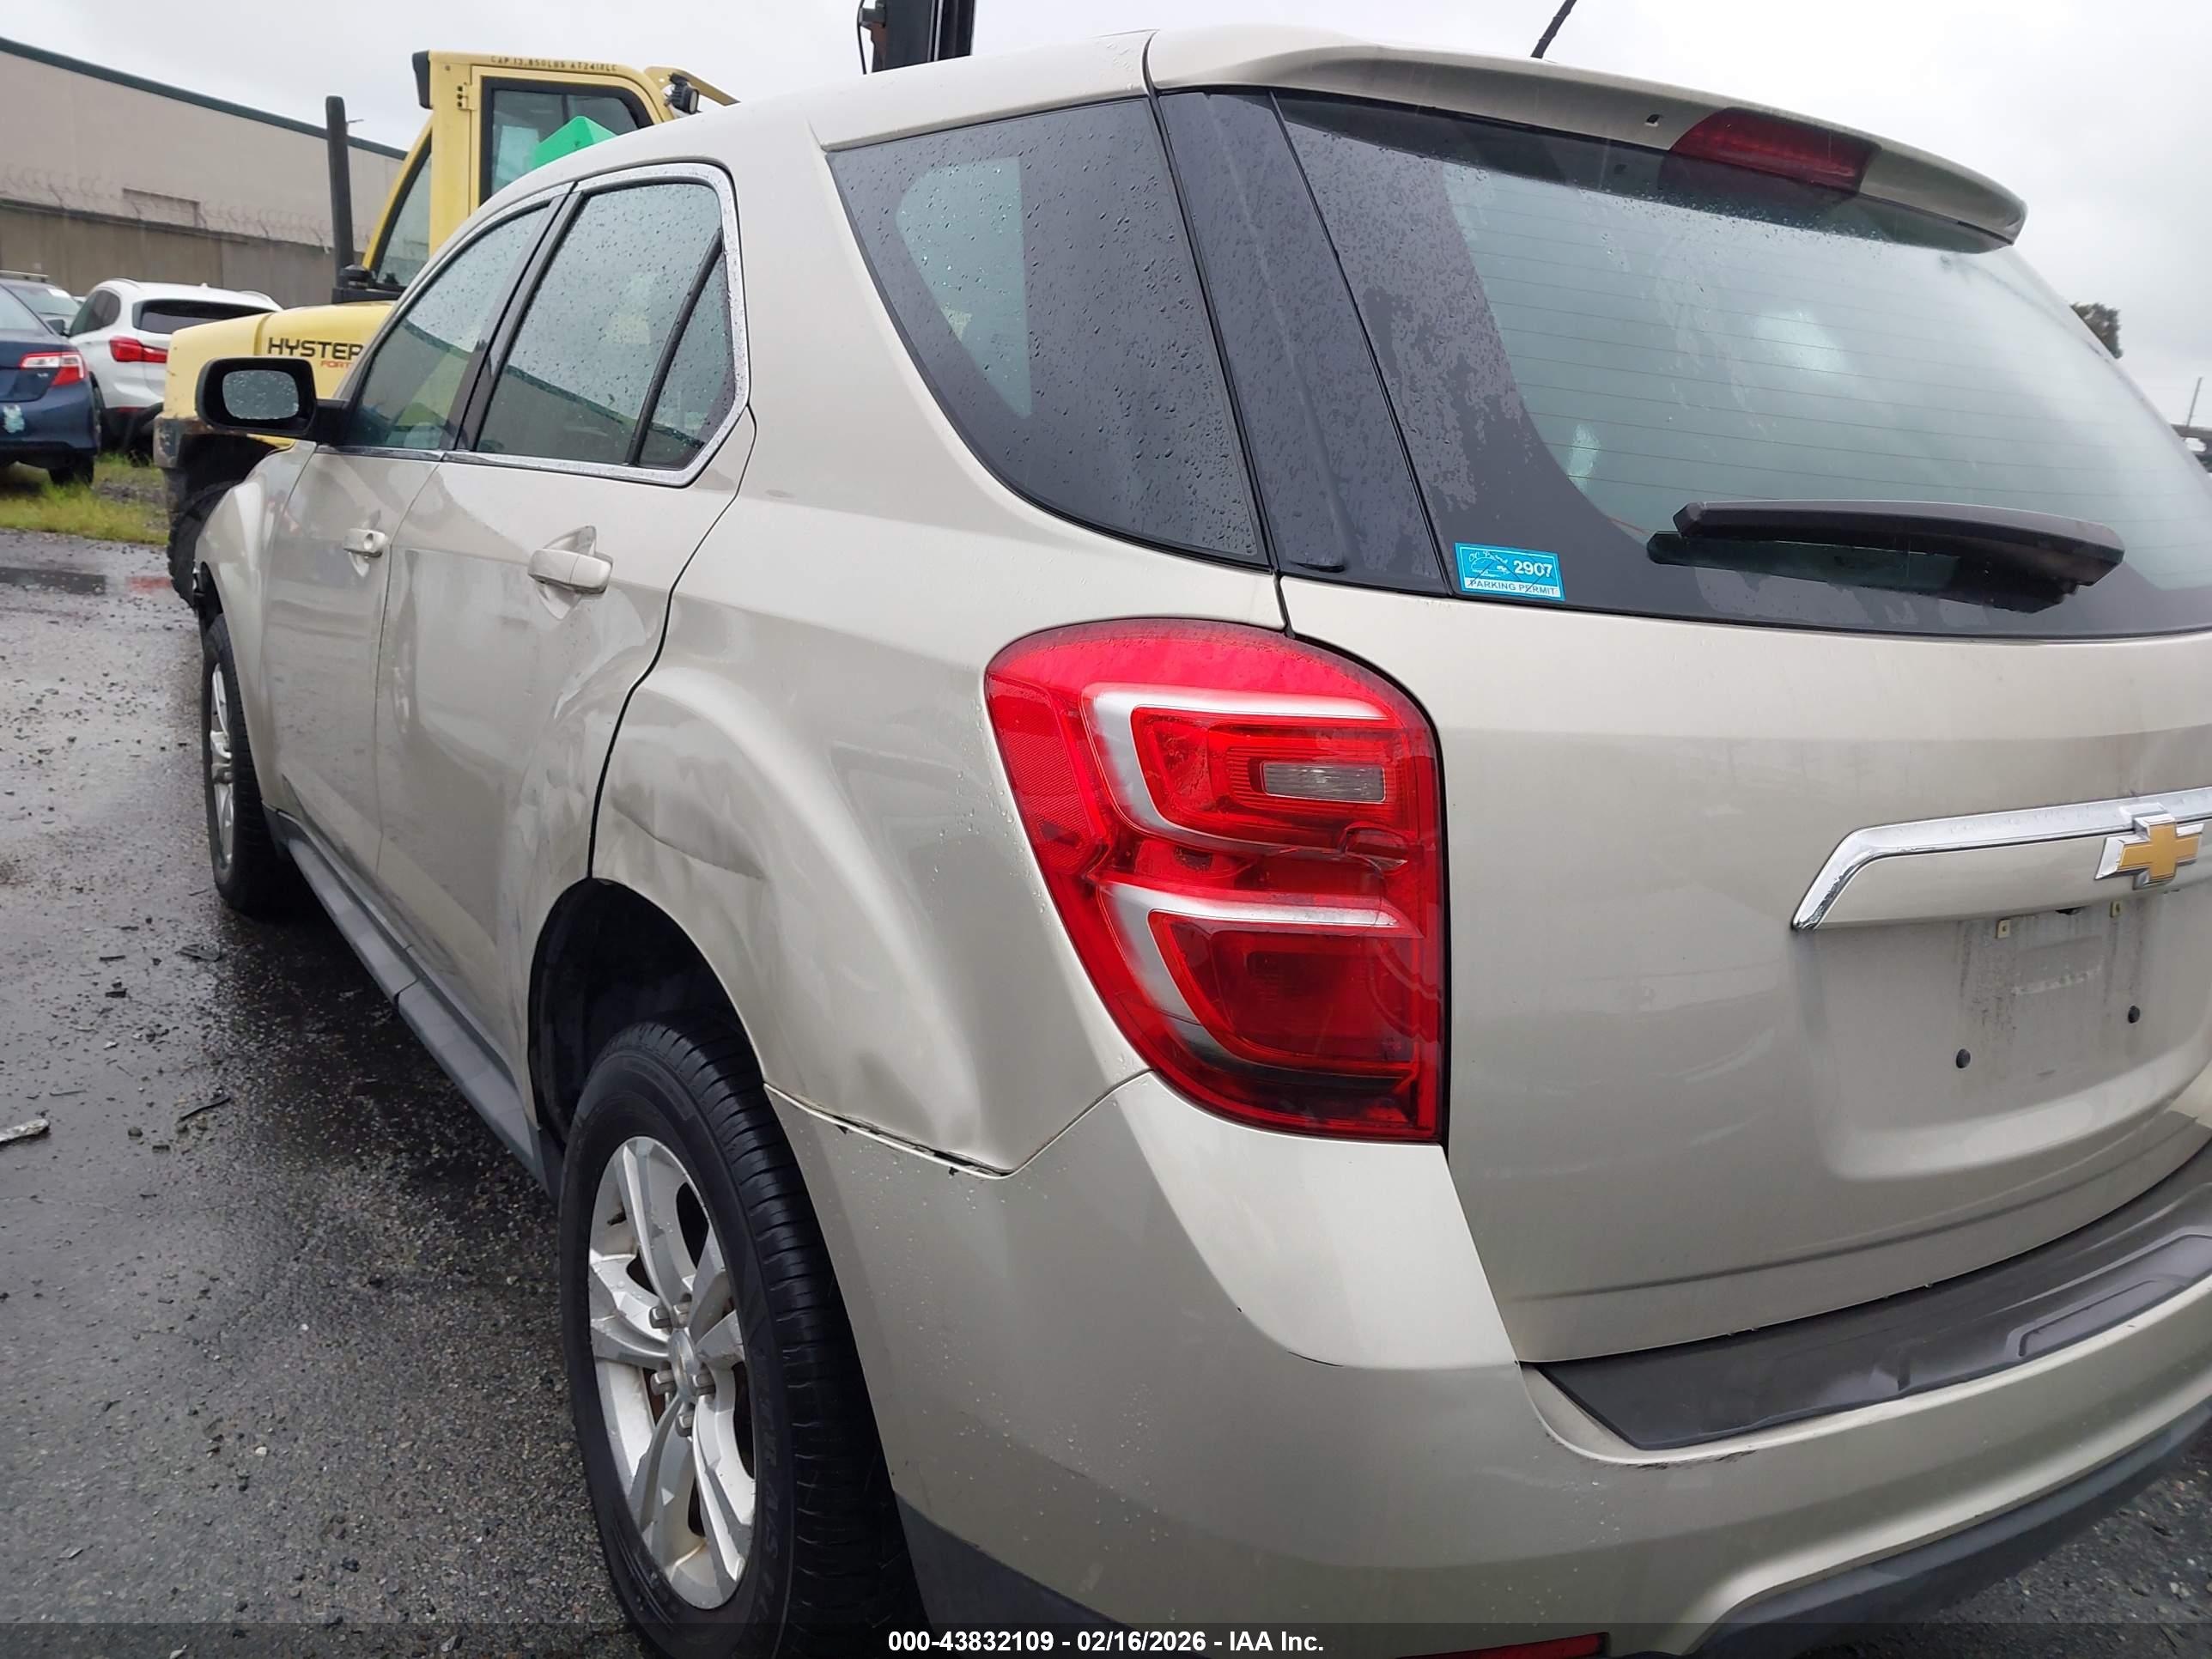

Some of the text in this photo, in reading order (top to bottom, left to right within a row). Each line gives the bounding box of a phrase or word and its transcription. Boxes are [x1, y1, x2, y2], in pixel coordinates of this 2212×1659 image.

[1513, 560, 1553, 578] 2907
[1469, 579, 1556, 596] PARKING PERMIT
